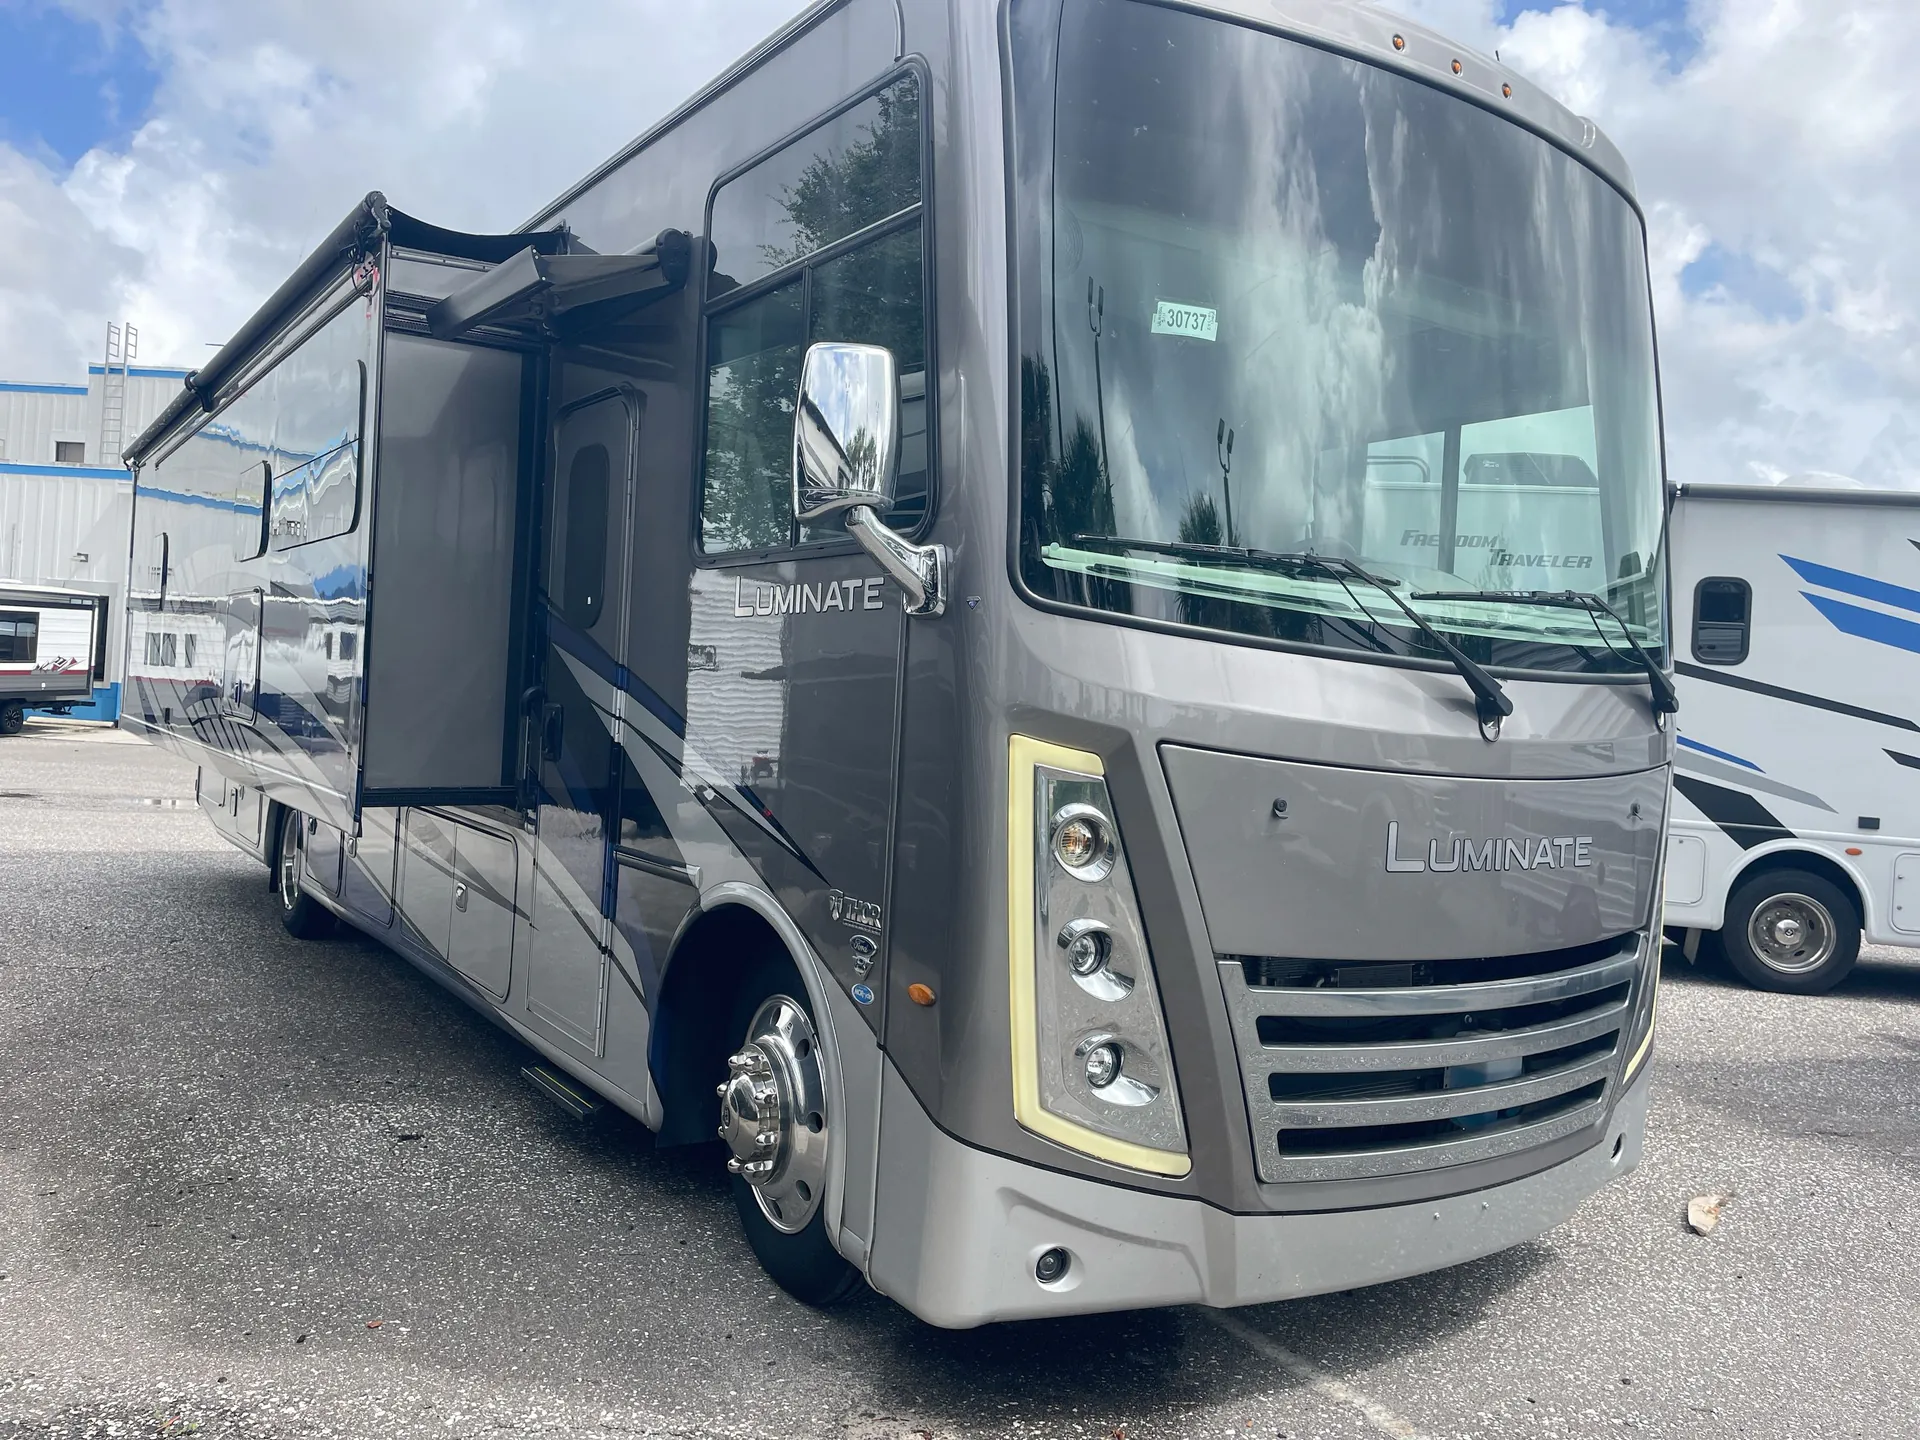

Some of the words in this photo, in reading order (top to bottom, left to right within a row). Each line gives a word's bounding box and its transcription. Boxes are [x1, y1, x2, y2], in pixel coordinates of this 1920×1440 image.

[1166, 308, 1207, 331] 30737
[1400, 529, 1499, 548] FREDOM
[1489, 548, 1592, 569] TRAVELER
[734, 575, 885, 617] LUMINATE
[1385, 820, 1593, 872] LUMINATE
[843, 896, 882, 928] THOR
